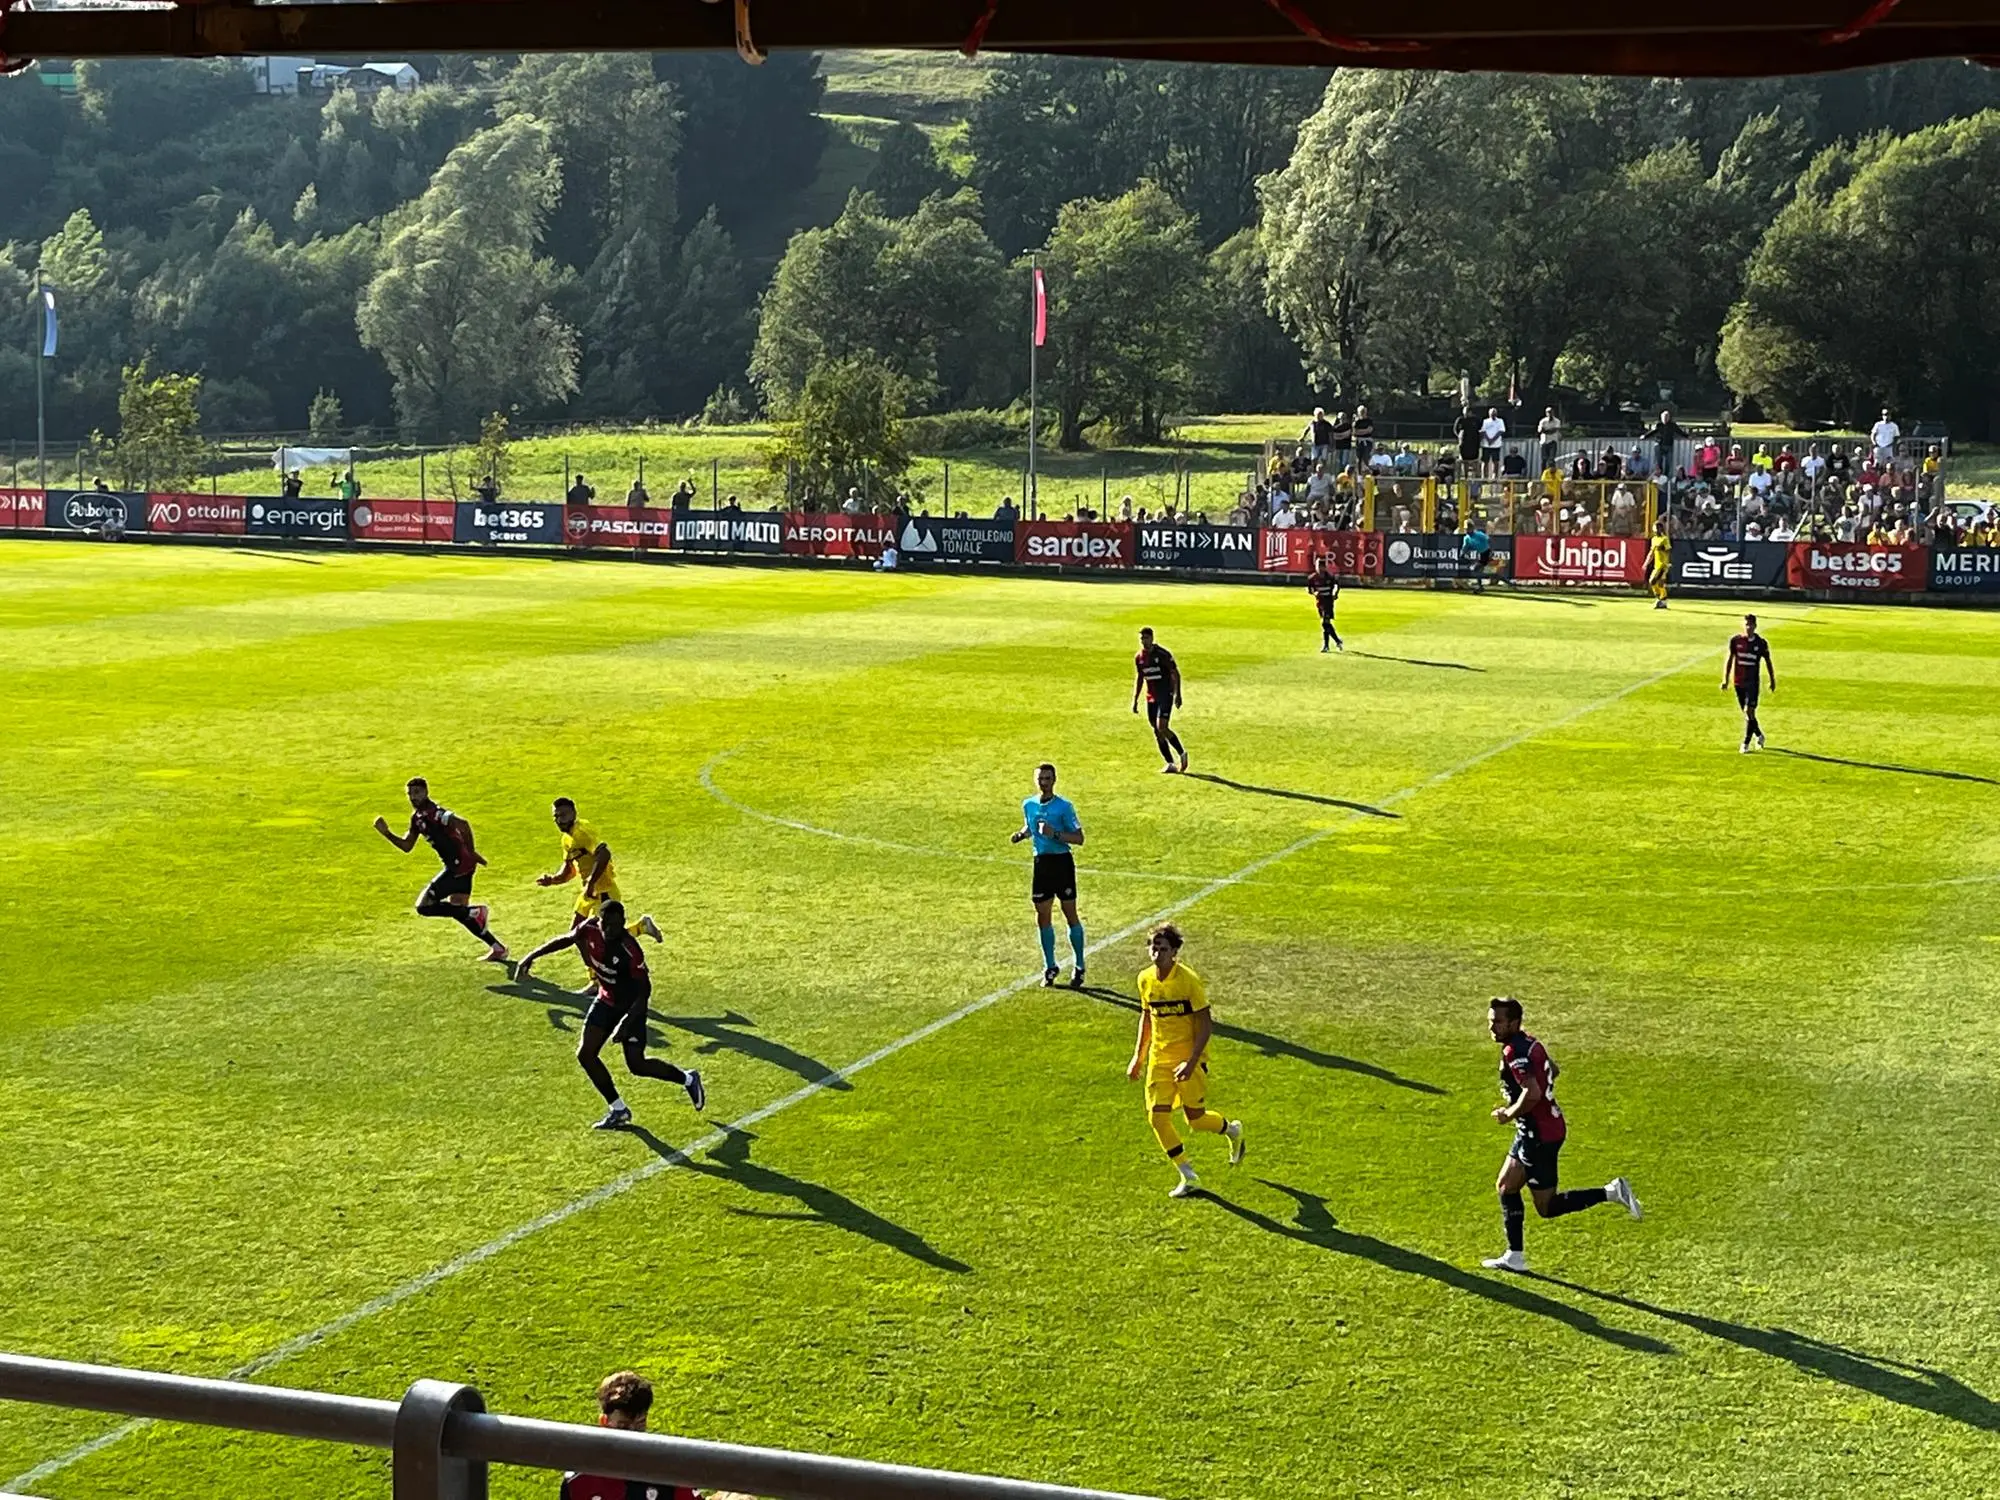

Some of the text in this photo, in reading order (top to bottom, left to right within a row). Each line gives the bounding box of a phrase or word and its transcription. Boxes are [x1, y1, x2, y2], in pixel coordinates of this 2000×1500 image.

[187, 505, 247, 520] ottolini
[267, 508, 345, 531] energit
[474, 508, 544, 528] bet365
[591, 519, 668, 535] PASCUCCI
[675, 520, 780, 544] DOPPIO MALTO
[786, 527, 896, 544] AEROITALIA
[490, 531, 527, 541] Scores
[942, 541, 983, 554] TONALE
[1027, 532, 1122, 558] sardex
[1141, 550, 1180, 560] GROUP
[1294, 550, 1378, 569] TIRSO
[1545, 538, 1627, 576] Unipol
[1811, 549, 1902, 573] bet365
[1830, 574, 1880, 587] Scores
[1935, 574, 1981, 585] GROUP
